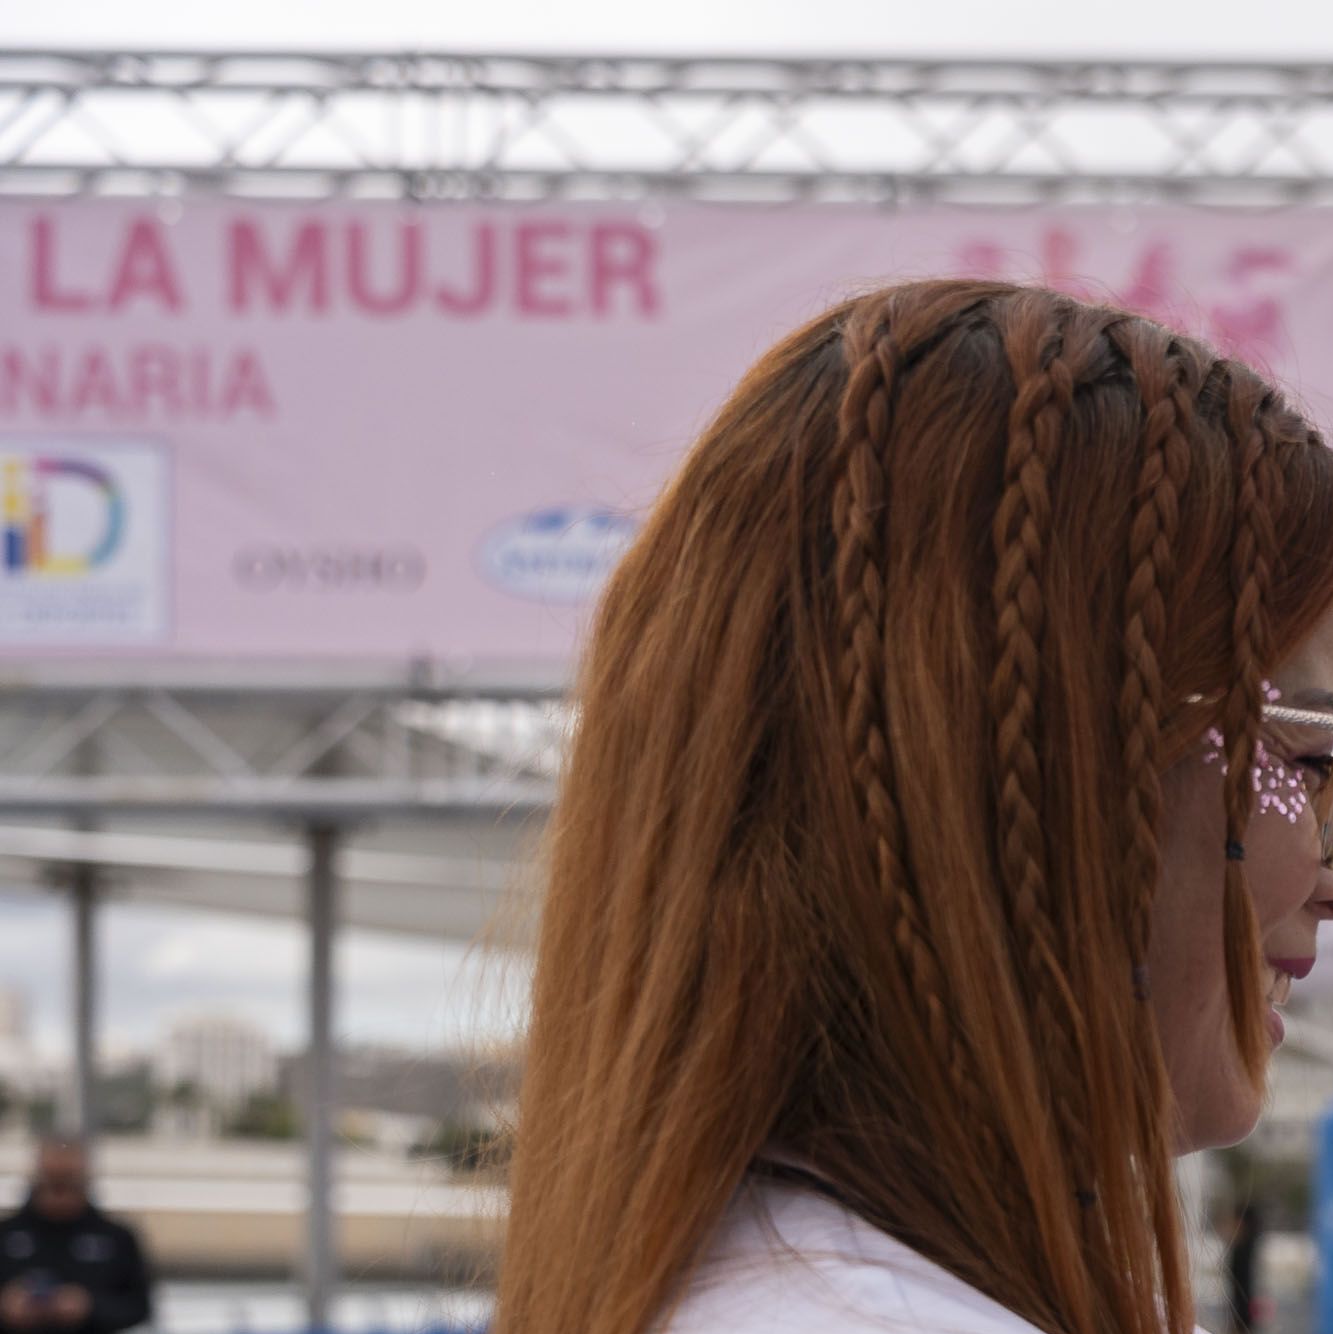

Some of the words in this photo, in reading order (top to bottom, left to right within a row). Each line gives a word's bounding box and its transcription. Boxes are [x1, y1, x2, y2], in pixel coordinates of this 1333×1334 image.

[26, 213, 186, 316] LA
[227, 213, 663, 319] MUJER
[1, 346, 275, 423] NARIA
